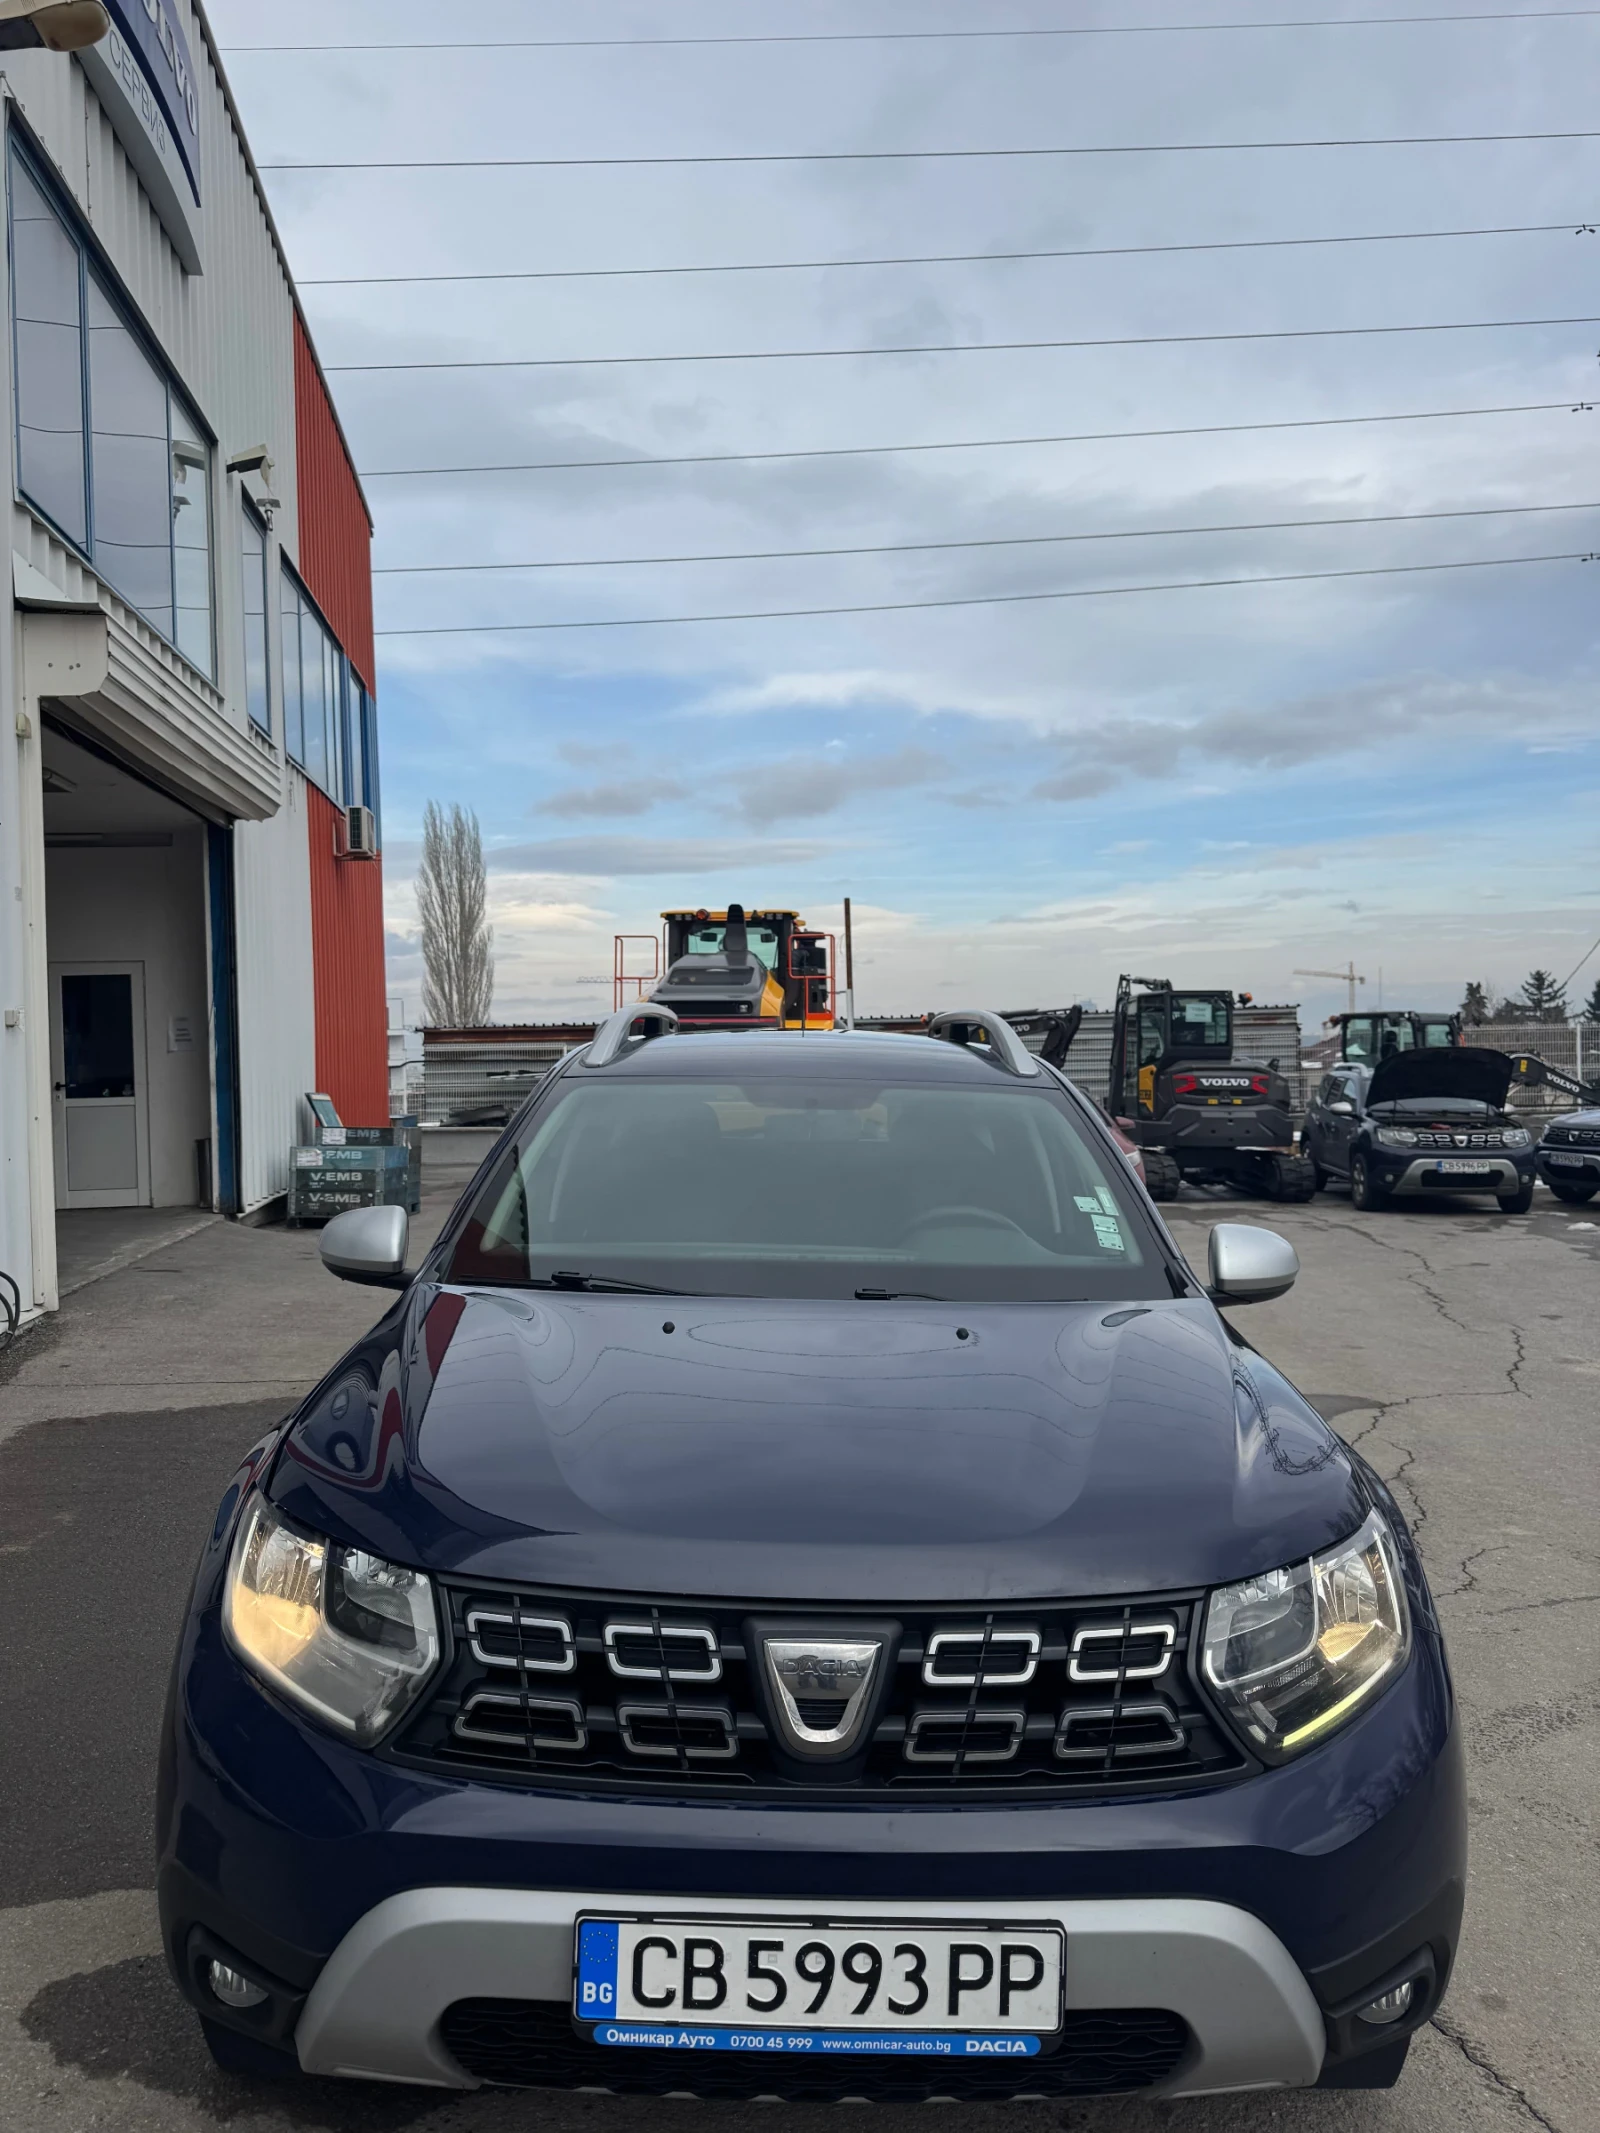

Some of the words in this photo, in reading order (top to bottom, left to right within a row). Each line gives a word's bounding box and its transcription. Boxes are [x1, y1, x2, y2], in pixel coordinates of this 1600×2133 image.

[143, 0, 197, 136] LVO
[109, 29, 165, 154] СЕРВИЗ
[1199, 1078, 1250, 1087] VOLVO
[1546, 1072, 1580, 1092] VOLVO
[347, 1129, 380, 1138] EMB
[322, 1150, 363, 1160] -EMB
[310, 1172, 362, 1181] V-EMB
[783, 1659, 862, 1676] DACIA
[582, 1981, 613, 2004] BG
[606, 2029, 674, 2046] Омникар
[678, 2032, 715, 2048] Ауто
[730, 2035, 764, 2047] 0700
[766, 2037, 784, 2049] 45
[787, 2037, 813, 2049] 999
[822, 2039, 951, 2053] www.omnicar-auto.bg
[965, 2041, 1027, 2052] DACIA
